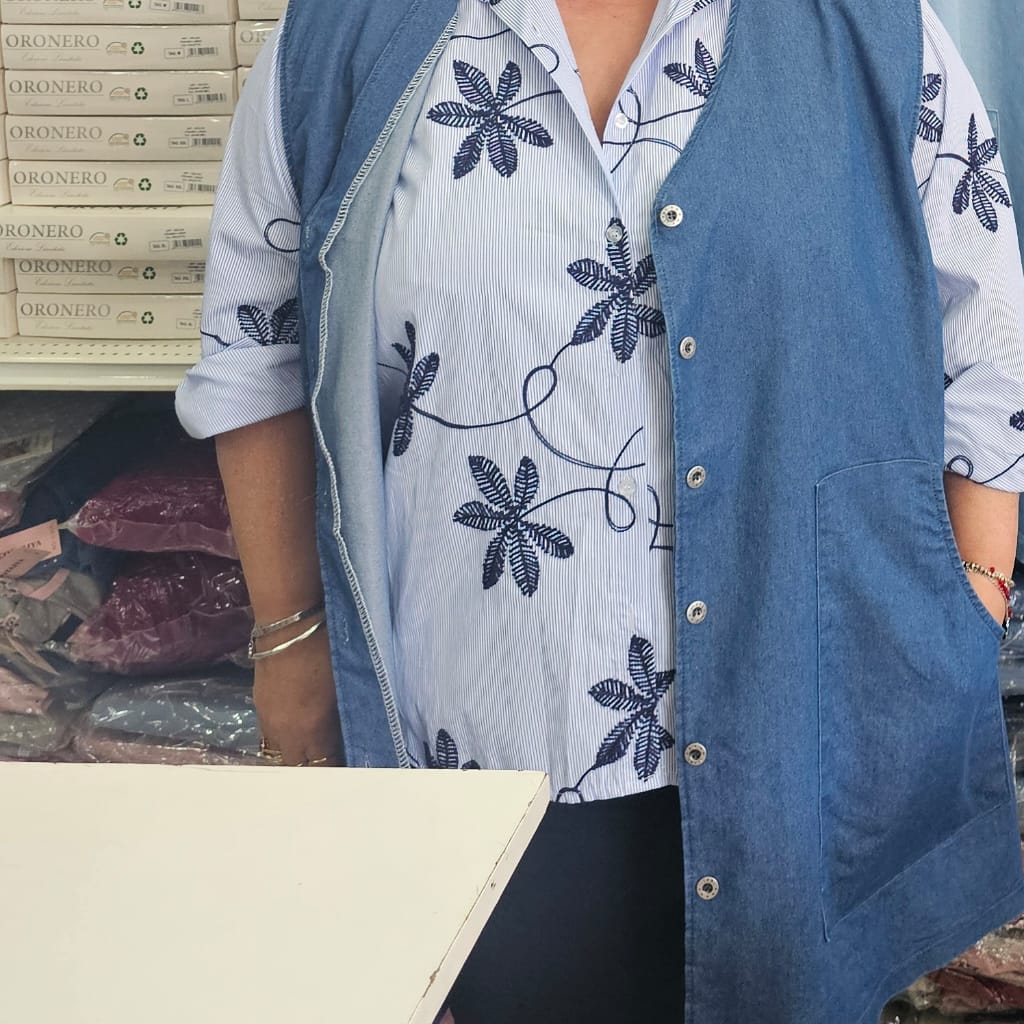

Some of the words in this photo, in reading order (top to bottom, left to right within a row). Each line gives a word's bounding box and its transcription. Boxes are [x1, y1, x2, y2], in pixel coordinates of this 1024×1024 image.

[5, 34, 100, 49] ORONERO
[9, 80, 103, 94] ORONERO
[10, 126, 103, 139] ORONERO
[13, 171, 107, 184] ORONERO
[19, 260, 112, 273] ORONERO
[21, 303, 110, 317] ORONERO
